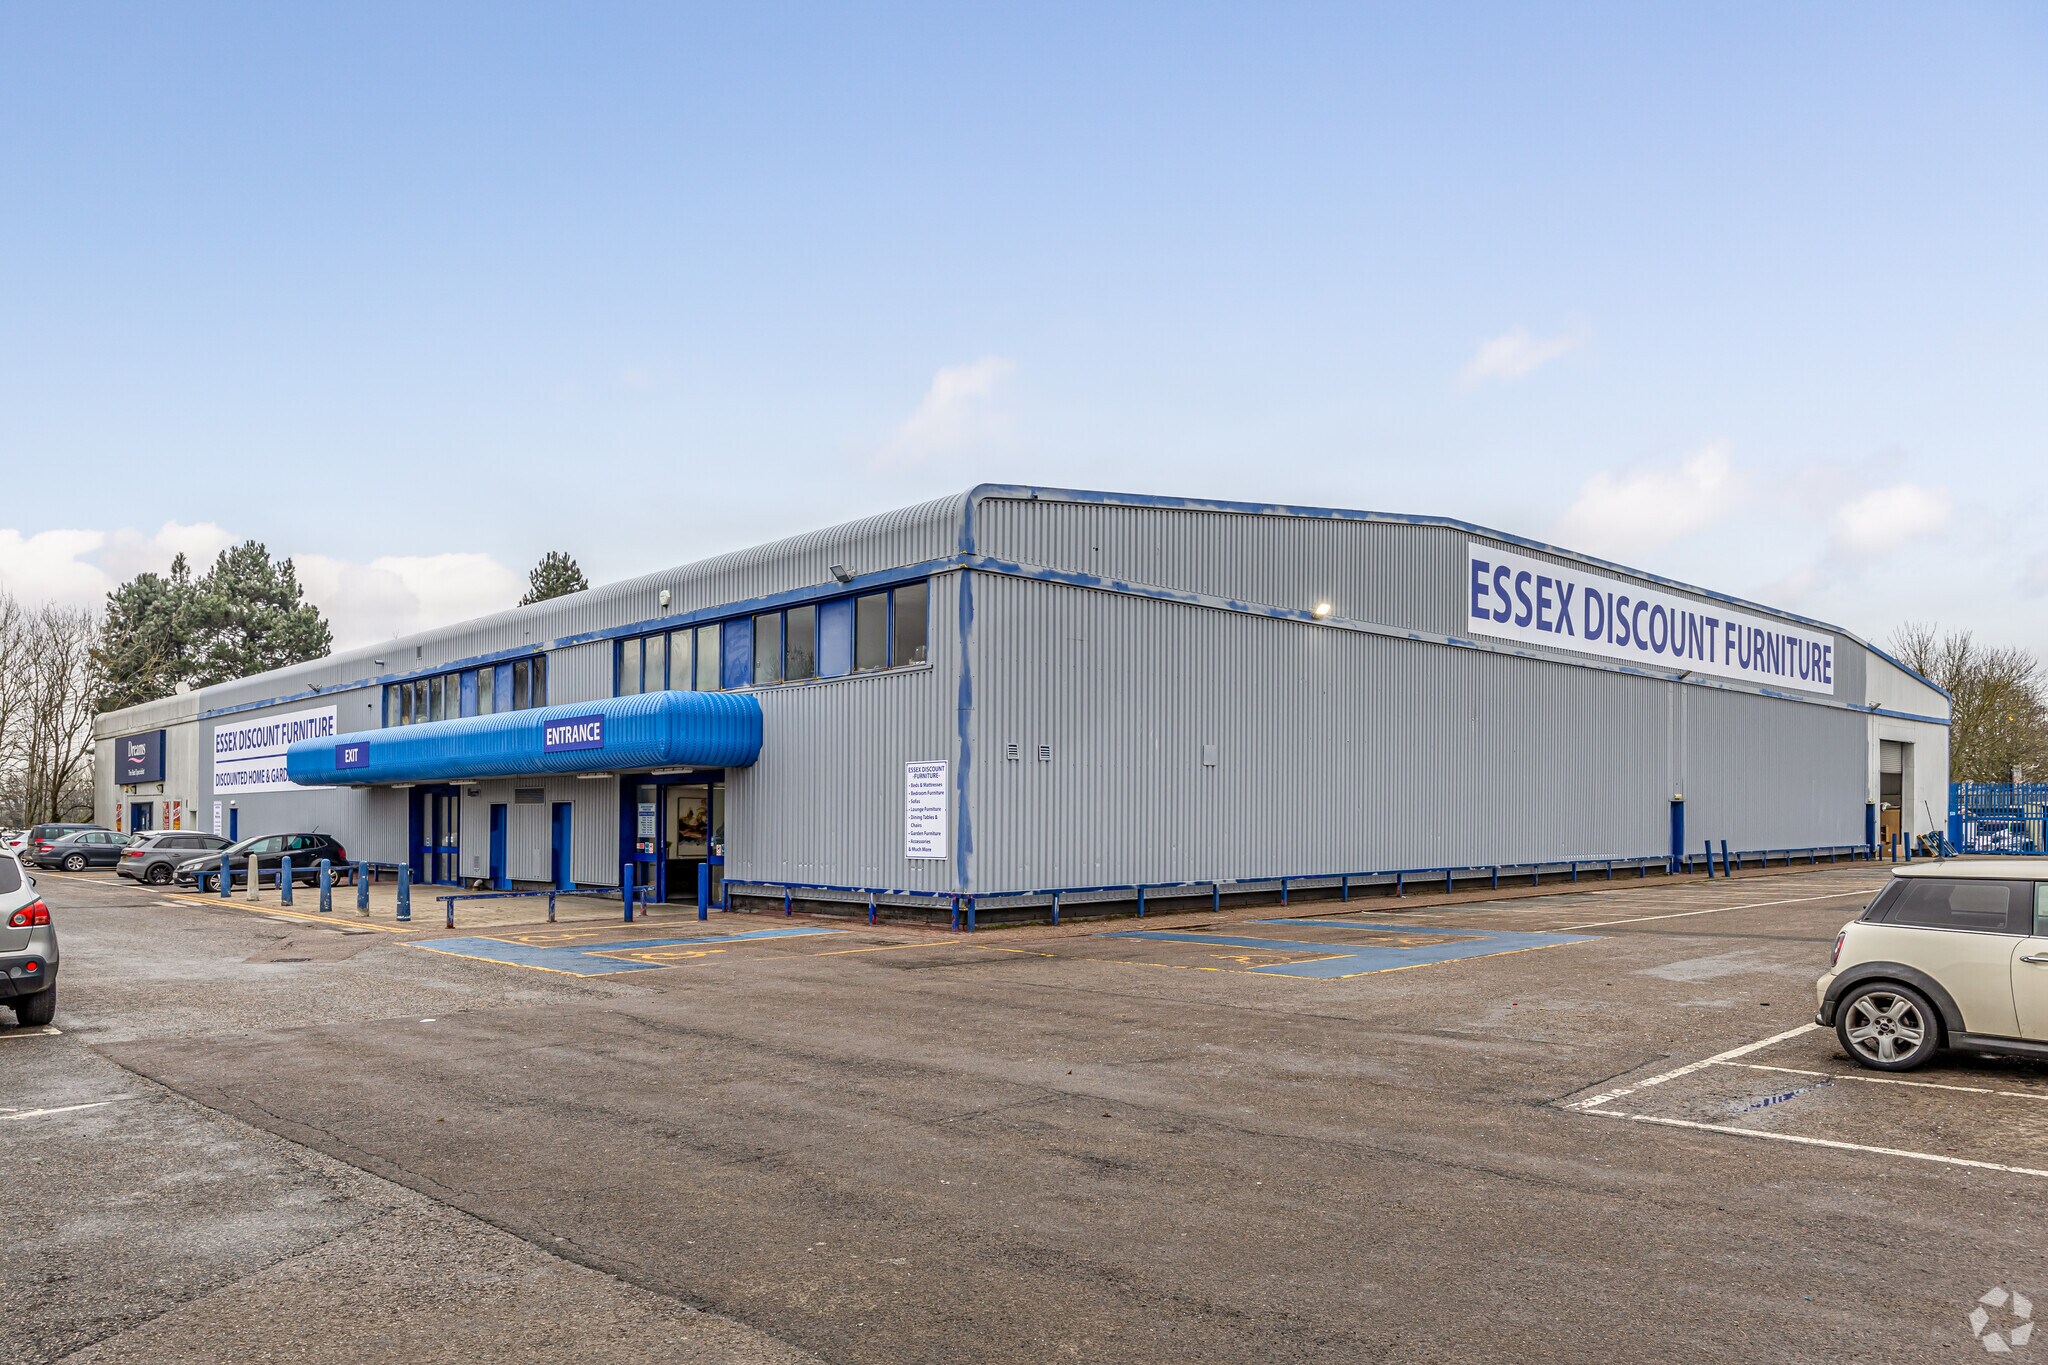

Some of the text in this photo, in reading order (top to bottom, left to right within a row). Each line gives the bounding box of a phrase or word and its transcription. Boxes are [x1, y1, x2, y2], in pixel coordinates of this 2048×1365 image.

[1471, 558, 1832, 685] ESSEX DISCOUNT FURNITURE
[216, 715, 334, 753] ESSEX DISCOUNT FURNITURE
[546, 722, 600, 746] ENTRANCE
[128, 740, 146, 757] Dreams
[345, 748, 358, 763] EXIT
[215, 767, 290, 787] DISCOUNTED HOME & GARD
